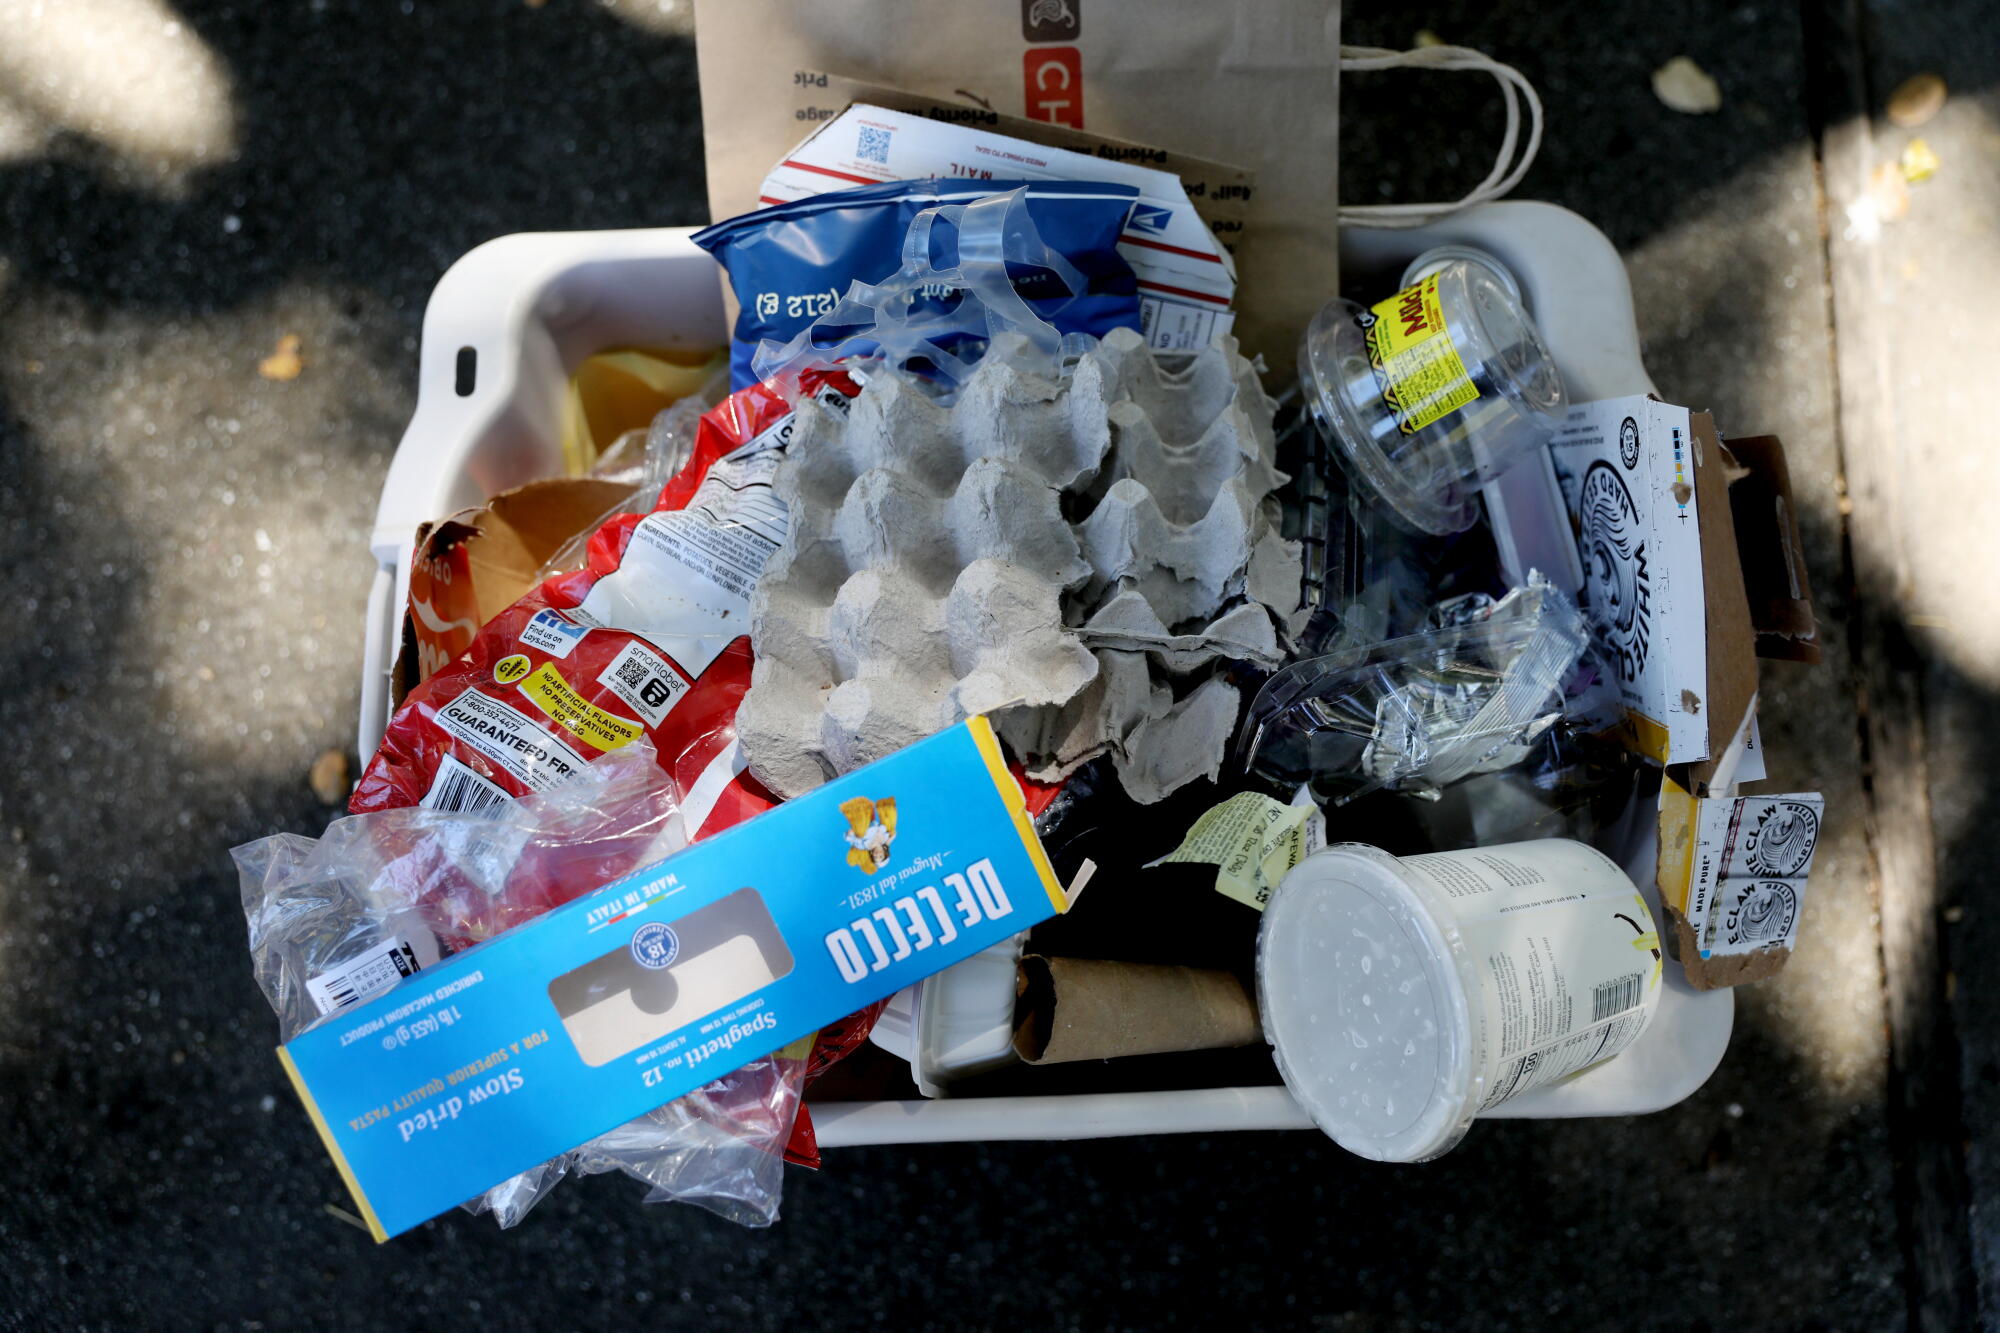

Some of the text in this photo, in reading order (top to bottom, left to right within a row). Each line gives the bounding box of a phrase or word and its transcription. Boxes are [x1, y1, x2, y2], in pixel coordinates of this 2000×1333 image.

[948, 162, 993, 182] MAIL
[755, 291, 779, 322] g)
[1600, 472, 1629, 520] HARD
[522, 631, 556, 650] Lays.com
[527, 623, 562, 644] Find us on
[461, 698, 520, 732] 1-800-352-4477
[539, 682, 553, 697] NO
[548, 693, 617, 743] PRESERVATIVES
[541, 669, 554, 685] NO
[549, 678, 595, 716] ARTIFICIAL
[590, 709, 634, 739] FLAVORS
[550, 707, 566, 723] NO
[453, 727, 477, 745] 9:00am
[480, 744, 504, 763] 4:30pm
[1286, 830, 1298, 871] AFEWA
[1746, 804, 1782, 879] WHITE CLAW
[1786, 805, 1814, 870] HARD SELTZER
[640, 871, 678, 898] MADE
[844, 847, 946, 910] Mugnai dal 1831
[583, 897, 624, 925] ITALY
[622, 889, 641, 907] IN
[1695, 885, 1706, 913] MADE
[1726, 883, 1756, 930] CLAW
[1766, 883, 1792, 911] SELTZER
[820, 855, 1015, 992] DE CECCO
[392, 954, 407, 972] SIZE
[646, 940, 667, 960] 18
[381, 957, 398, 976] USA
[337, 967, 484, 1047] ENRICHED MACARONI PRODUCT
[436, 1006, 454, 1027] lb
[719, 1010, 737, 1025] TIME
[734, 996, 765, 1017] COOKING
[392, 1022, 417, 1047] g)
[409, 1011, 441, 1040] (453
[520, 1027, 549, 1050] FOR
[698, 1021, 713, 1035] MIN
[633, 1052, 650, 1065] MIN
[639, 1006, 780, 1088] Spaghetti no. 12
[655, 1038, 678, 1055] DENTE
[444, 1046, 510, 1087] SUPERIOR
[1522, 1049, 1539, 1075] 130
[388, 1076, 446, 1113] QUALITY
[394, 1064, 527, 1144] Slow dried
[347, 1102, 391, 1133] PASTA
